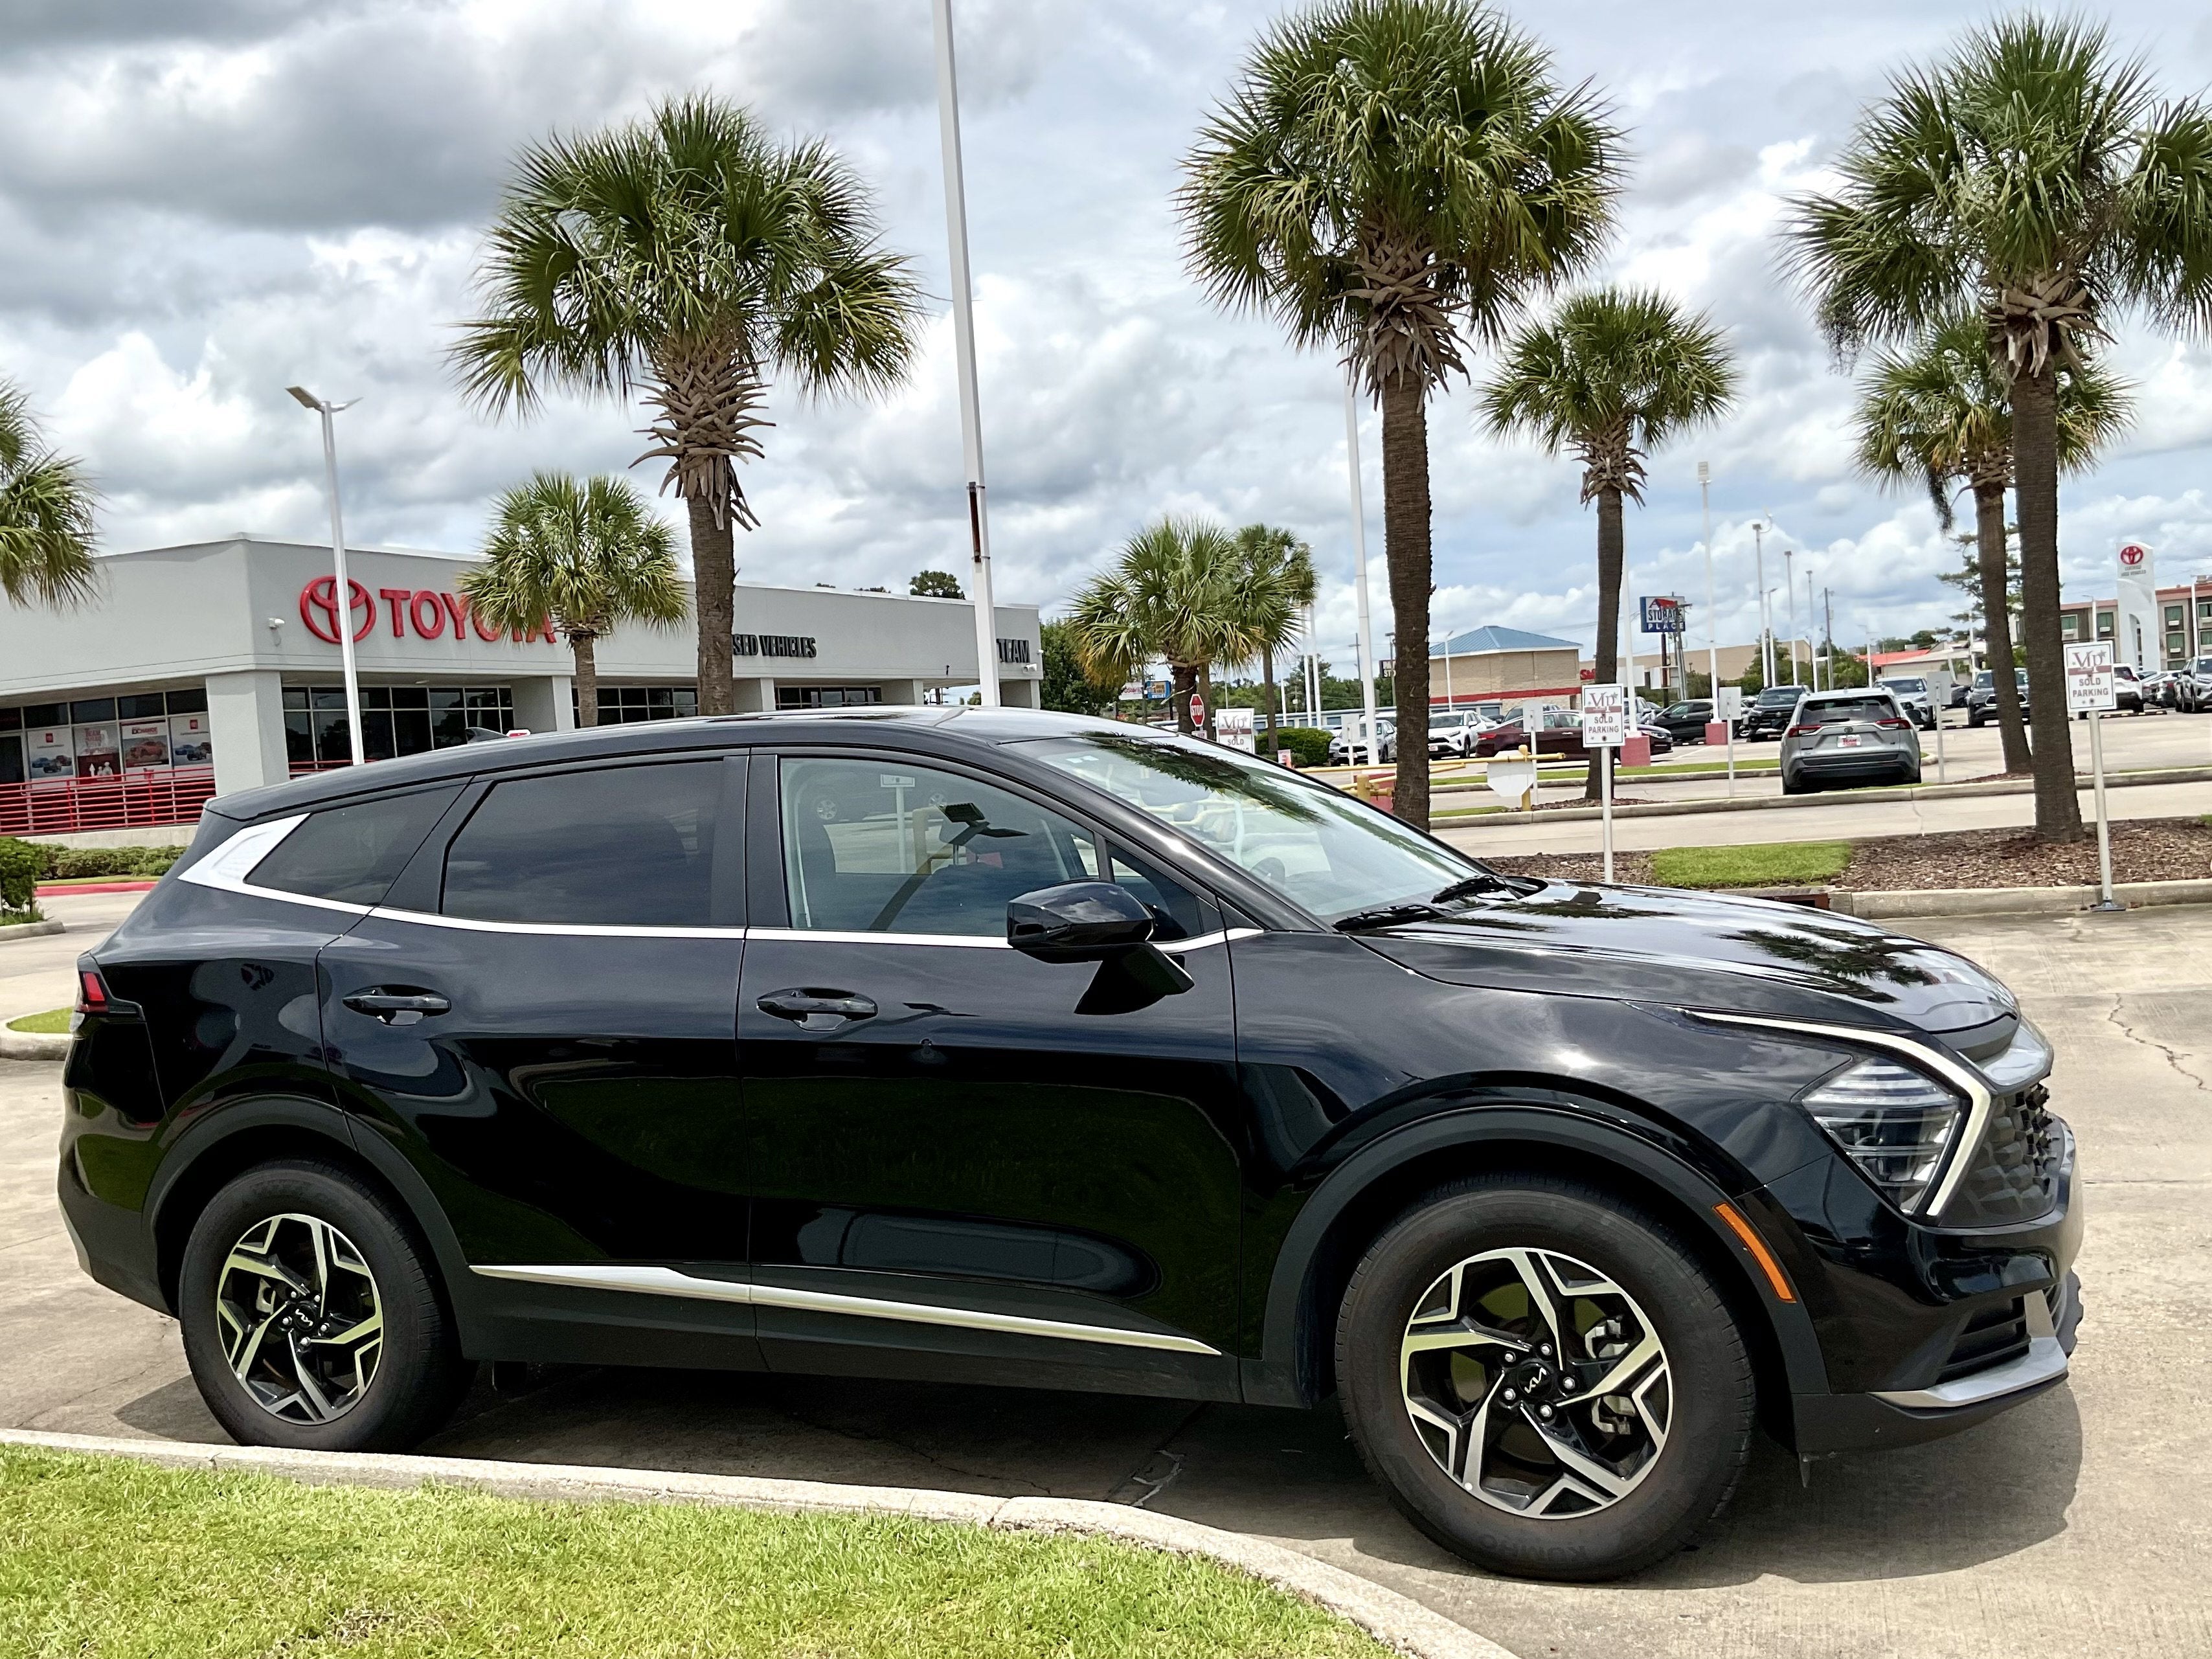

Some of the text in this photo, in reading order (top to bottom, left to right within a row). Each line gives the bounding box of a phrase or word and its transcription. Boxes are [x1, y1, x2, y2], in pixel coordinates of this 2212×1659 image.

[379, 588, 557, 644] TOYO
[732, 633, 817, 658] SED VEHICLES
[996, 638, 1030, 663] TEAM
[2079, 677, 2101, 686] SOLD
[2073, 688, 2108, 697] PARKING
[1191, 705, 1203, 716] STOP
[1588, 725, 1620, 734] PARKING
